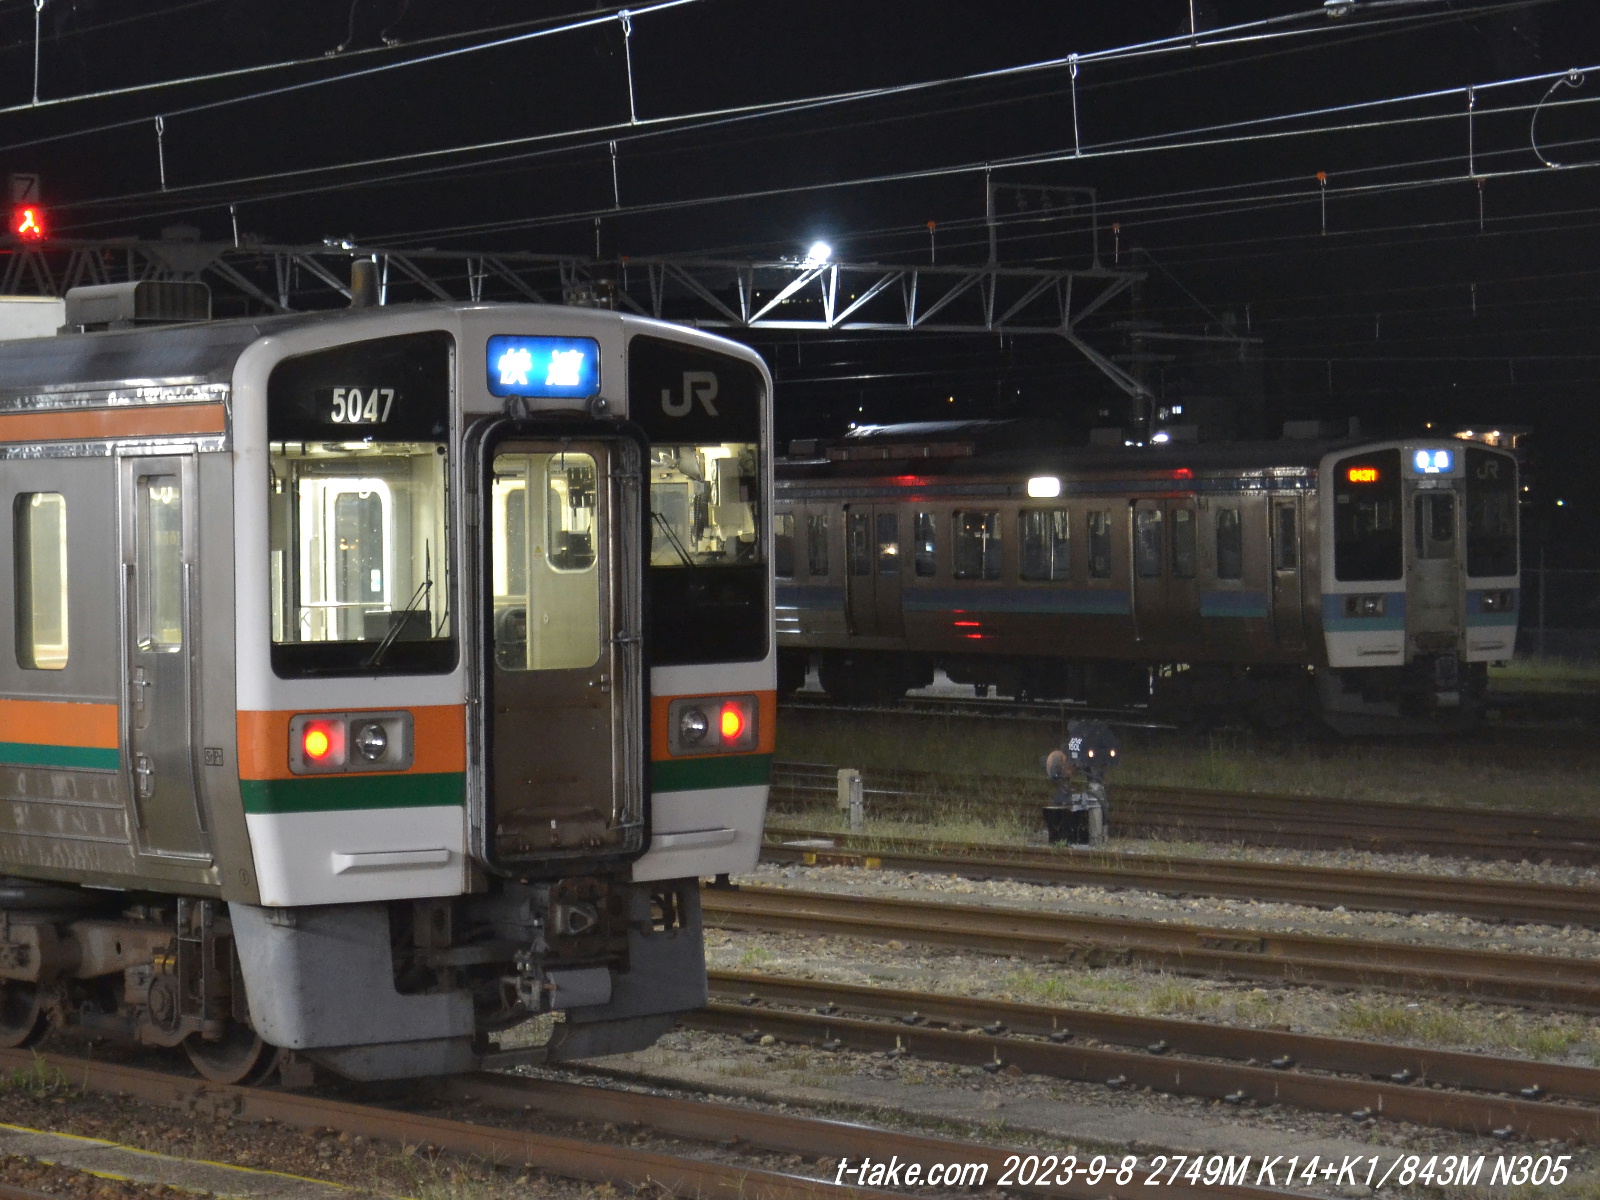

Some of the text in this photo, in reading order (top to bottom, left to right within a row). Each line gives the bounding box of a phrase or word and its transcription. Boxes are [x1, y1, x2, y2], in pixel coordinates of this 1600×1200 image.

[331, 388, 395, 423] 5047
[661, 371, 719, 417] JR
[1477, 460, 1499, 479] JR
